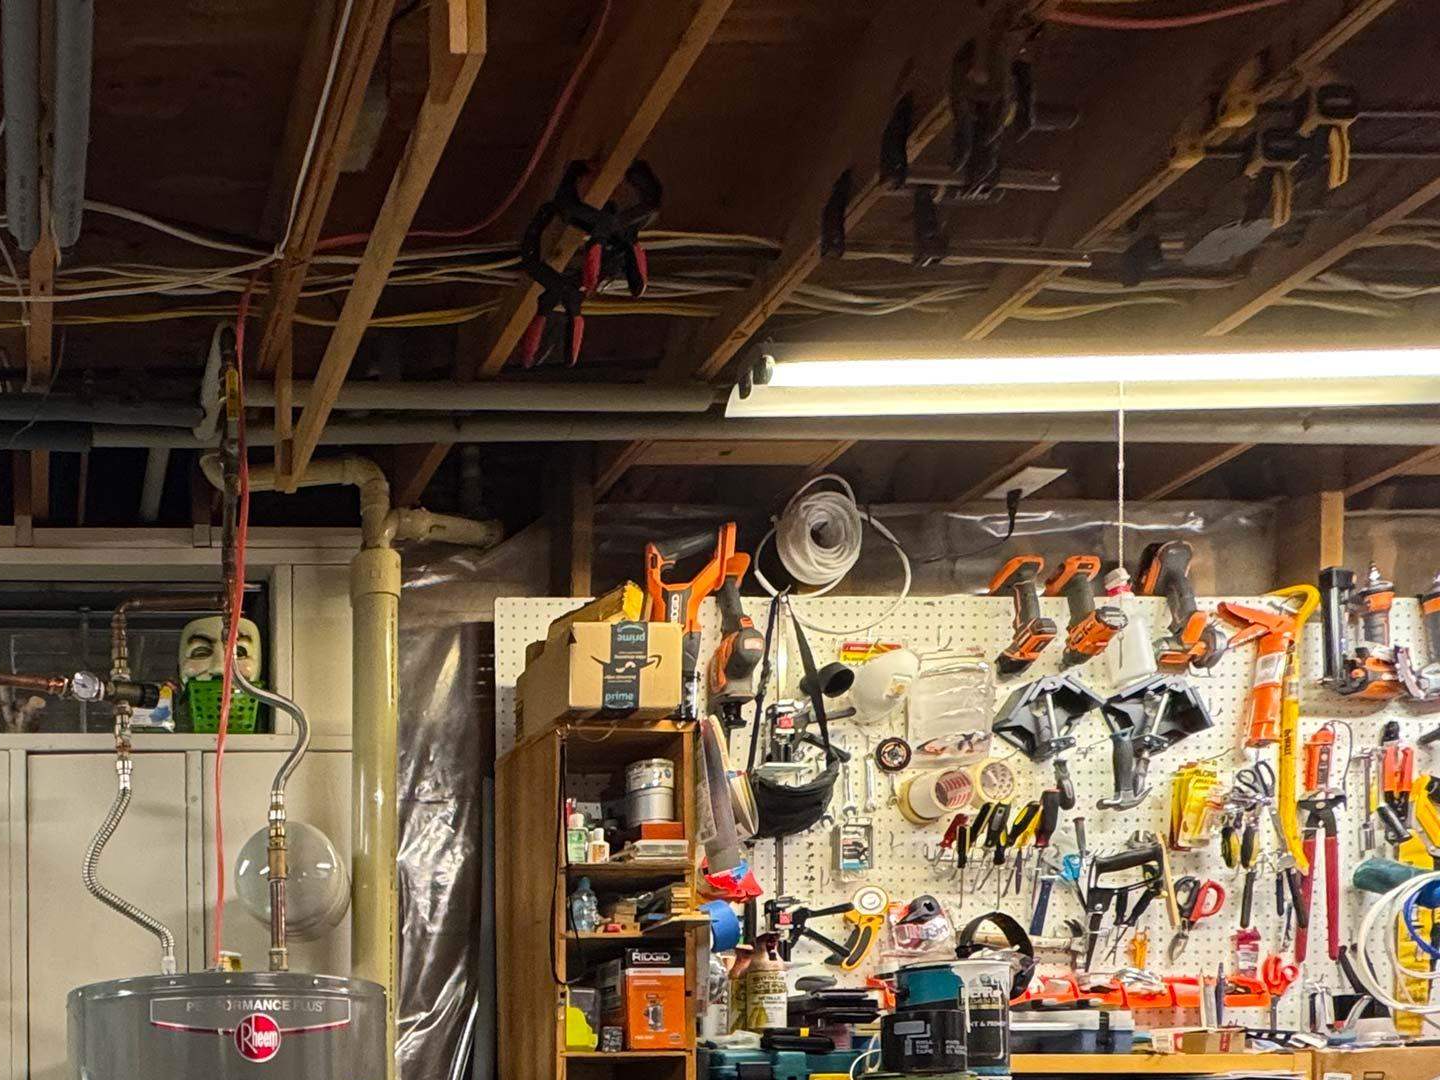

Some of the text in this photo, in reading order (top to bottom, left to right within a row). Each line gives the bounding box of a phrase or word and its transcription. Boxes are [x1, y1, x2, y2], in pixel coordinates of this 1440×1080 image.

[617, 633, 645, 643] prime
[605, 692, 634, 702] prime
[632, 951, 671, 962] RIDGID
[241, 1014, 278, 1055] Rheem
